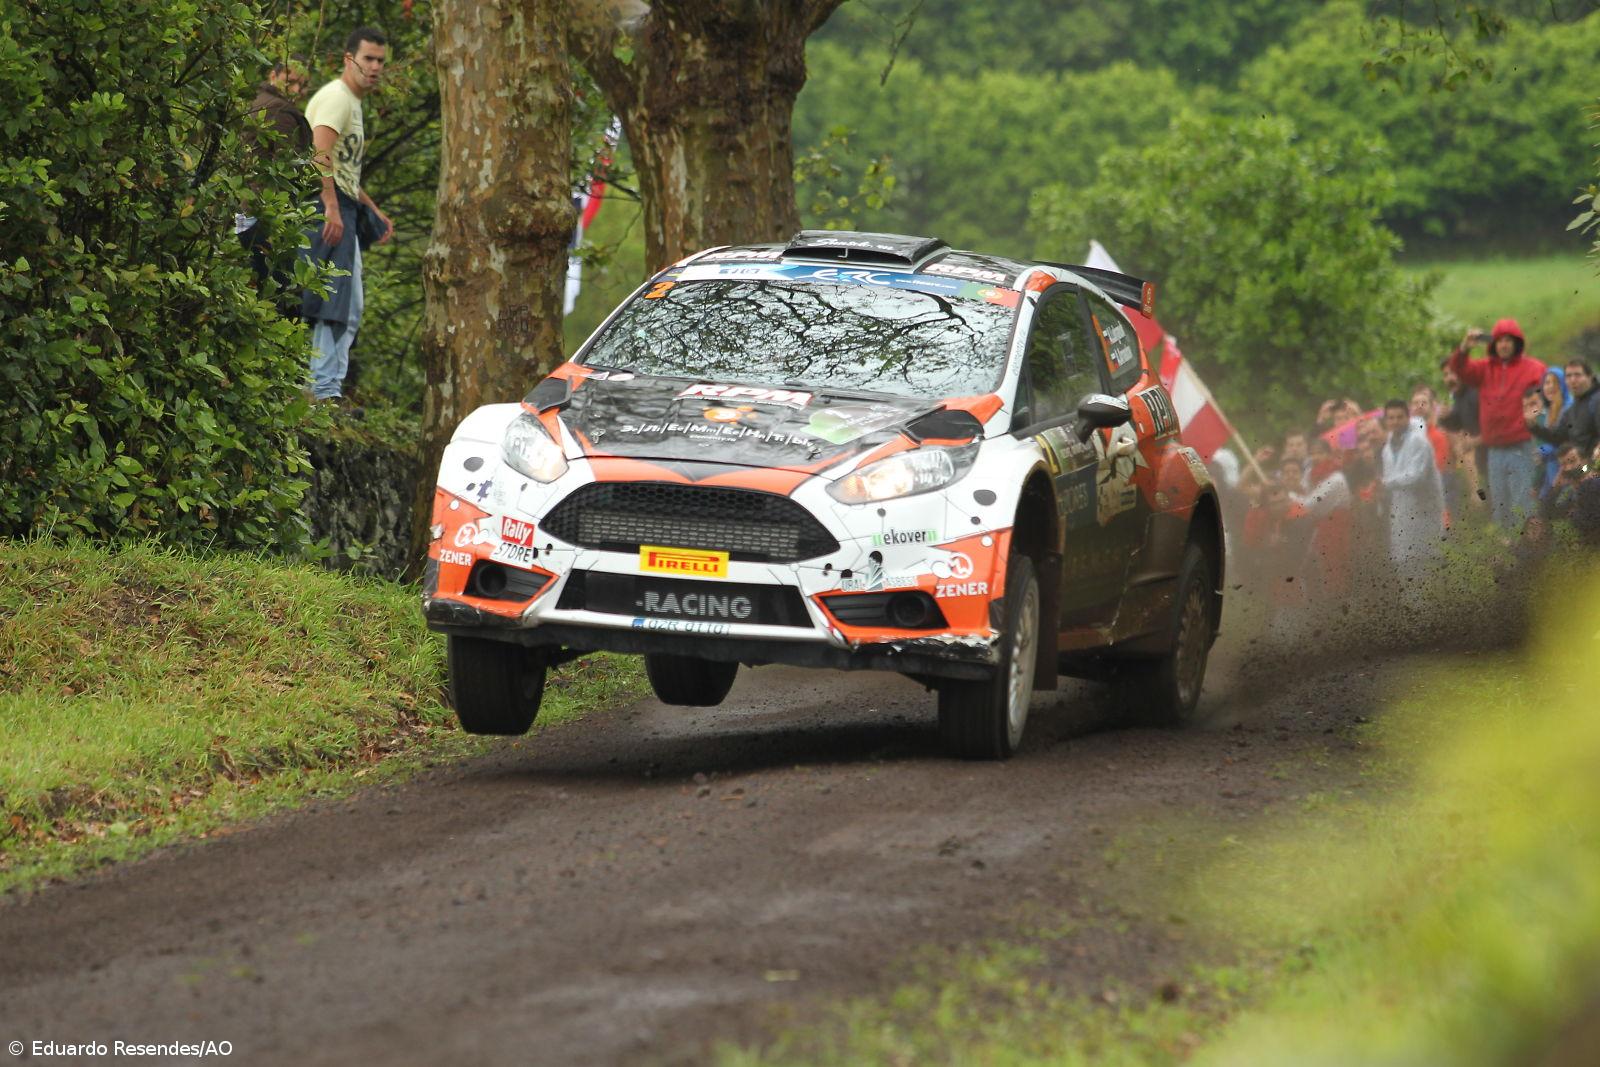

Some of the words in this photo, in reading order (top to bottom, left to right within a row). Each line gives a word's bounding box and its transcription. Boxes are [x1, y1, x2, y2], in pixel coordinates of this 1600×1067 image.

[678, 382, 814, 406] RPM
[503, 519, 533, 545] Rally
[883, 529, 927, 545] ekover
[440, 549, 472, 566] ZENER
[494, 541, 532, 563] STORE
[647, 551, 720, 573] PIRELLI
[936, 581, 989, 598] ZENER
[645, 591, 752, 619] RACING
